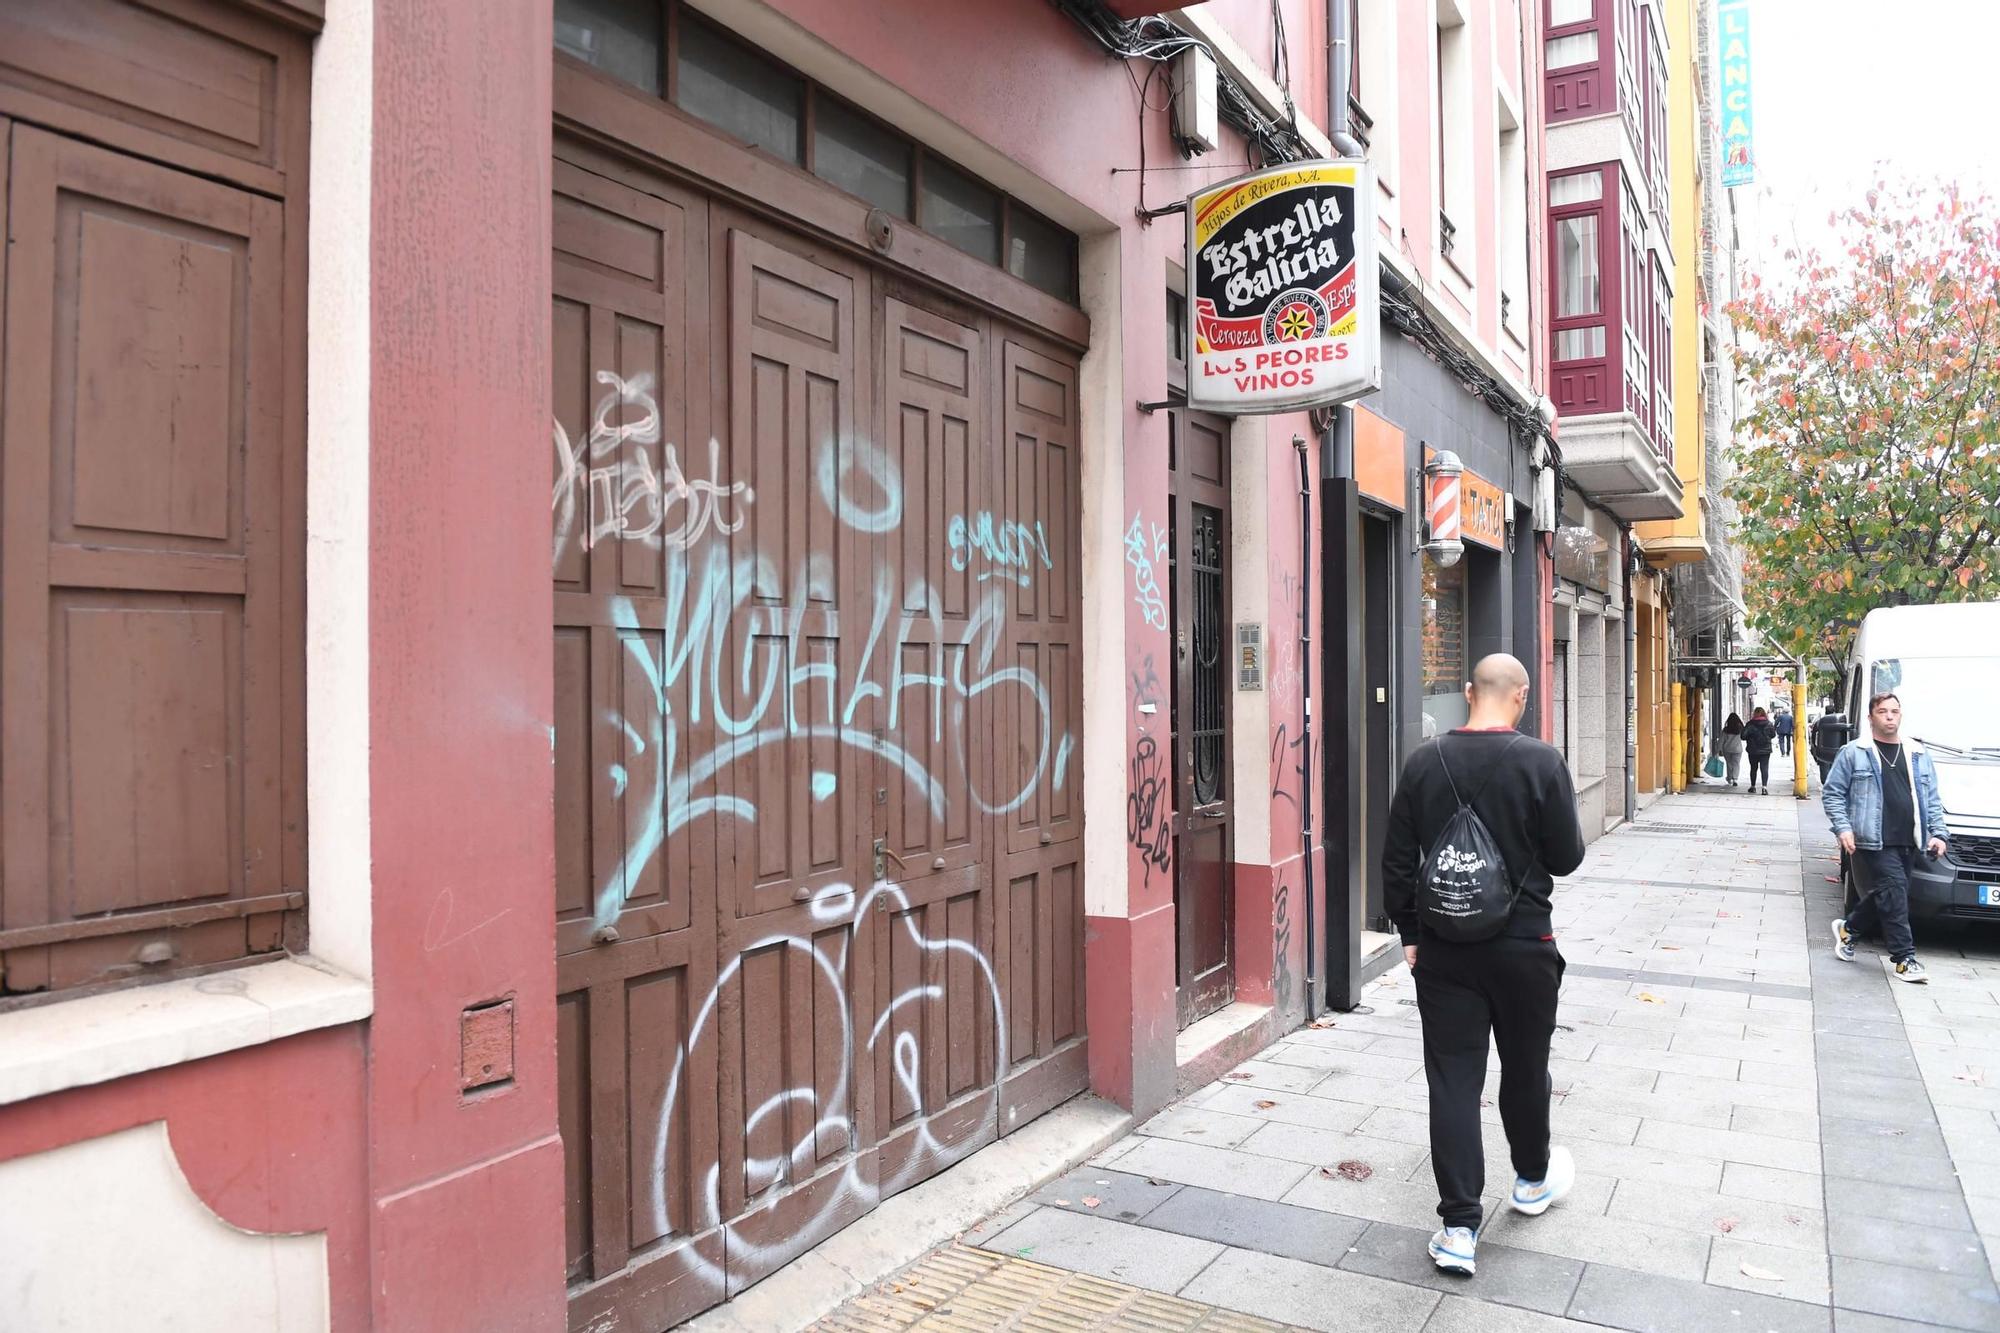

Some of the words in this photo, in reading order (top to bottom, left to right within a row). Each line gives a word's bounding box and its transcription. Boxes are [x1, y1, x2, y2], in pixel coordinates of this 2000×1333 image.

[1202, 205, 1232, 236] Hijos
[1232, 192, 1246, 211] de
[1248, 175, 1291, 201] Rivera,
[1294, 168, 1321, 185] S.A.
[1203, 196, 1343, 283] Estrella
[1225, 237, 1340, 312] Galicia
[1209, 322, 1259, 346] Cerveza
[1255, 342, 1350, 370] PEORES
[1234, 368, 1315, 393] VINOS
